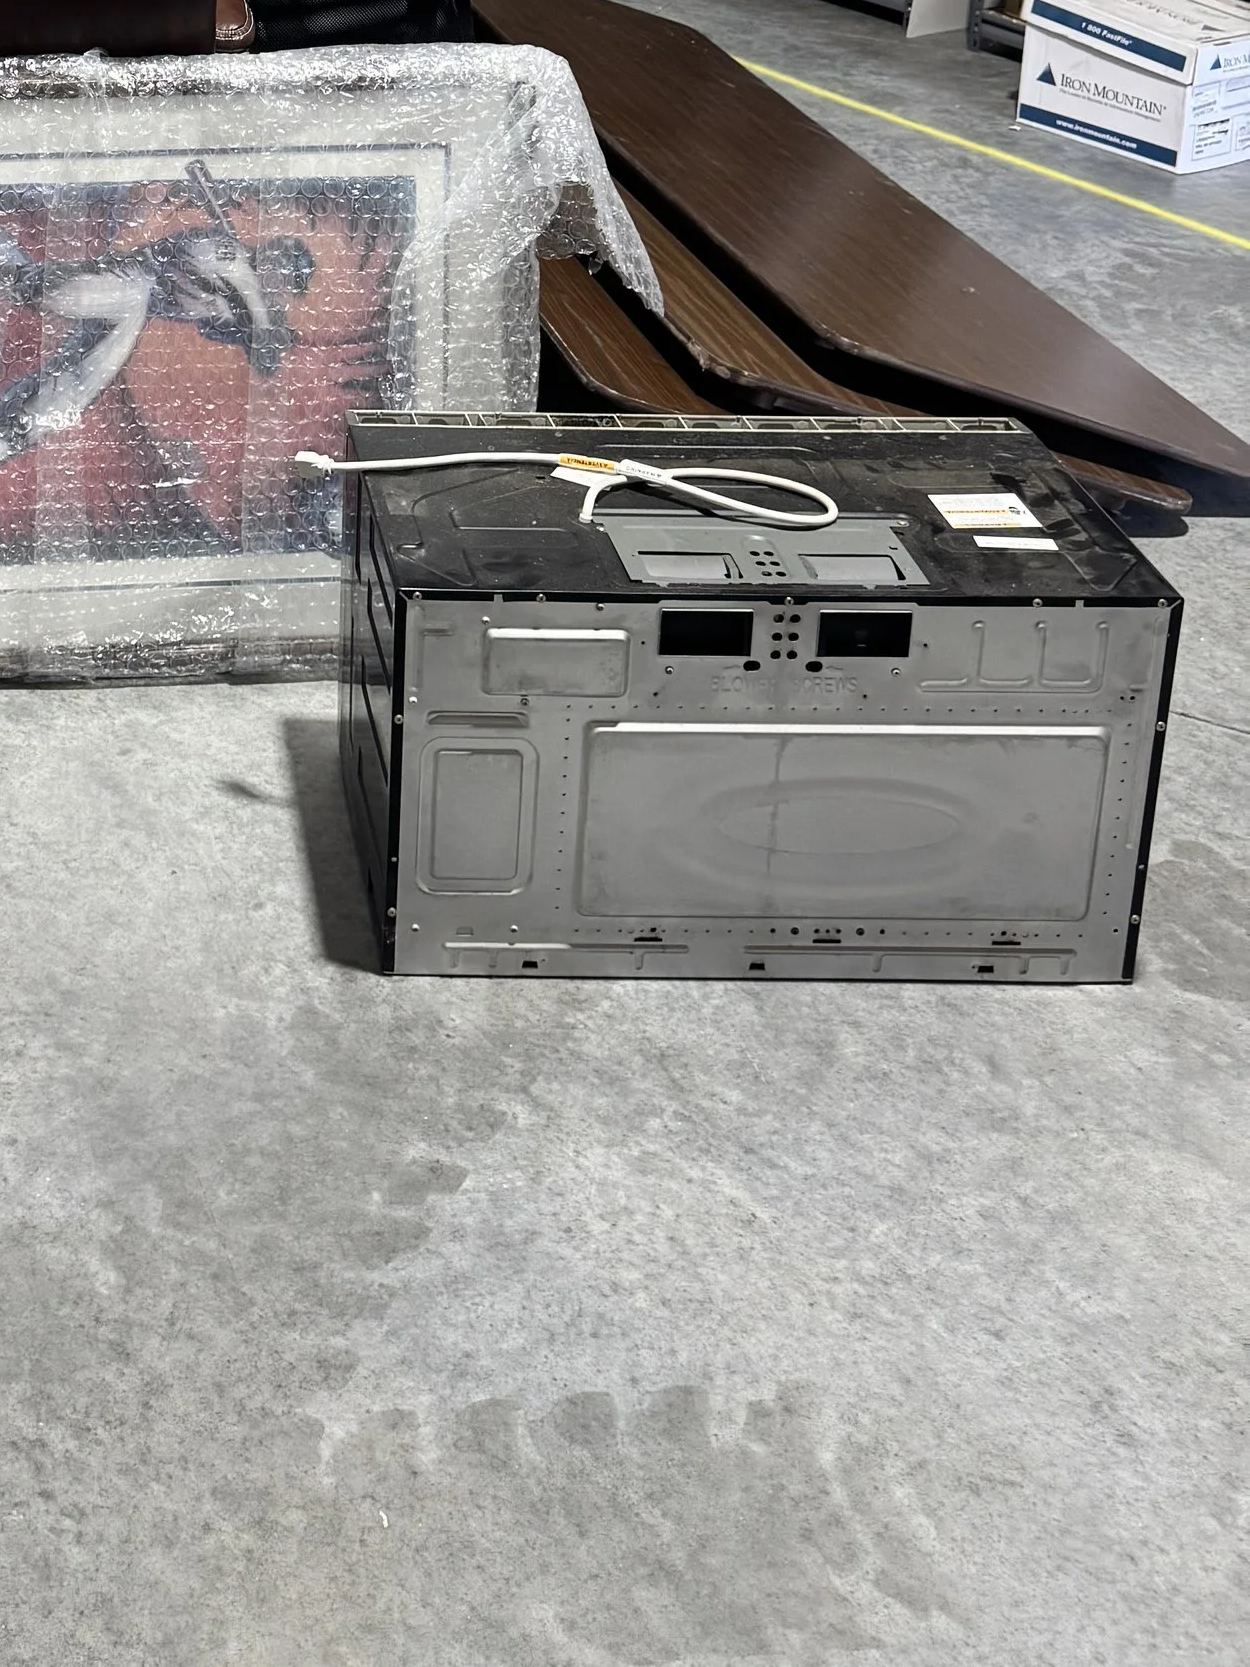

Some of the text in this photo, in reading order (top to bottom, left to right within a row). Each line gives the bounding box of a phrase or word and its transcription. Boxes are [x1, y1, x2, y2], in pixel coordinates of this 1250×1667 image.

[1087, 24, 1101, 35] 800
[1059, 73, 1163, 116] IRON MOUNTAIN
